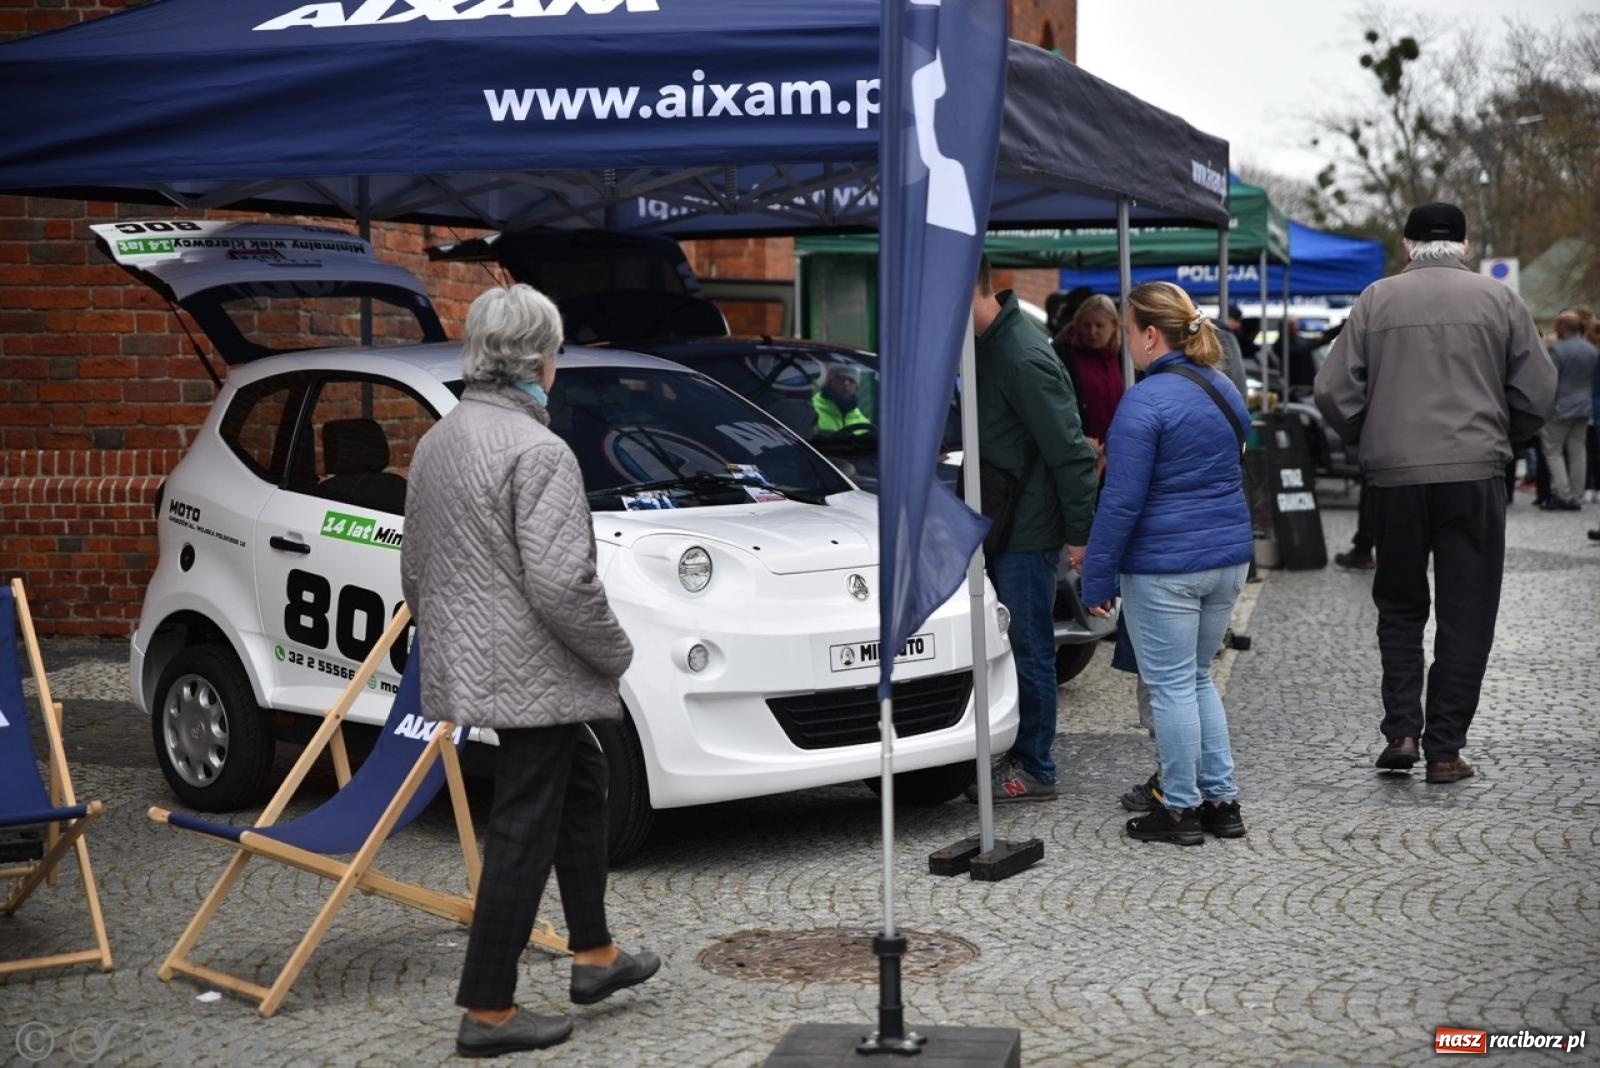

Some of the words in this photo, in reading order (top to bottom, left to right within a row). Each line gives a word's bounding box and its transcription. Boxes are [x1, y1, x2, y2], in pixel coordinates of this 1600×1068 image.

[169, 499, 201, 523] MOTO
[322, 516, 348, 532] 14
[349, 519, 375, 540] lat
[288, 651, 304, 666] 32
[307, 656, 315, 669] 2
